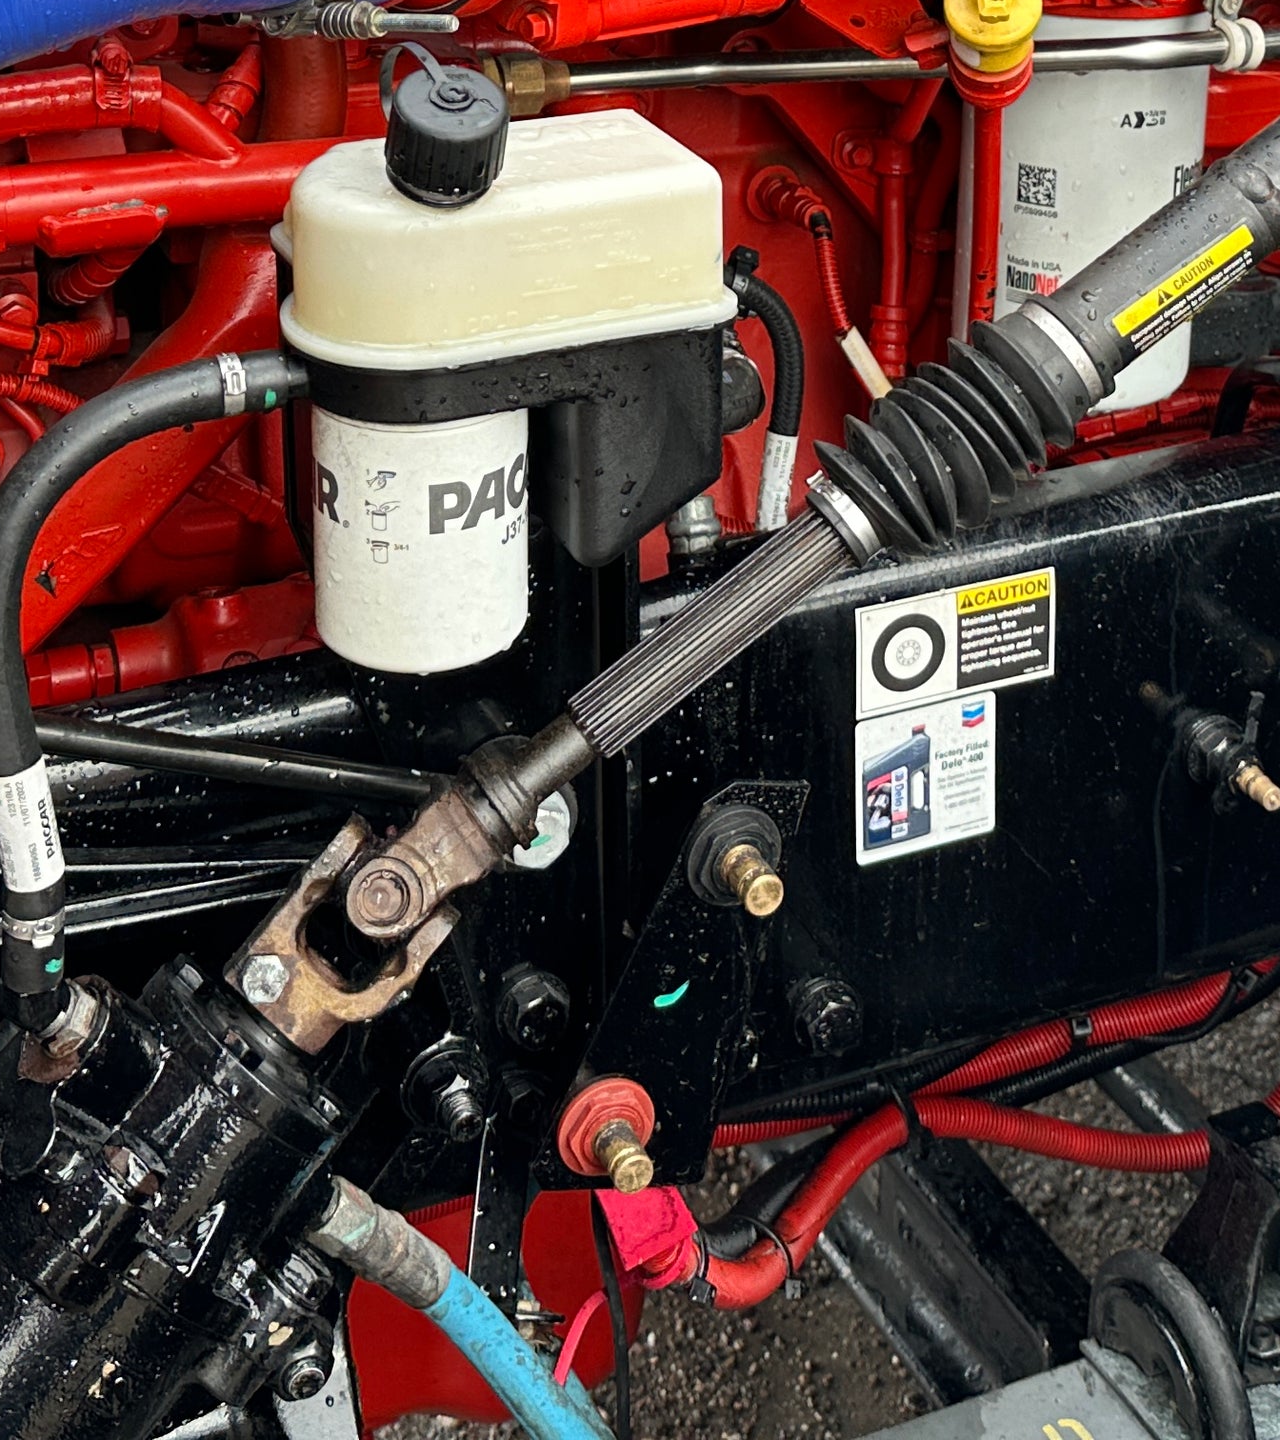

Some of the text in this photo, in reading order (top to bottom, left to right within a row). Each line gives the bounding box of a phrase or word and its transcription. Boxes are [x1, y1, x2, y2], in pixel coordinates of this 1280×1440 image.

[1006, 254, 1030, 268] Made
[1041, 260, 1062, 272] USA
[1173, 255, 1215, 291] CAUTION
[1006, 265, 1061, 297] NanoNet
[974, 578, 1048, 606] CAUTION
[961, 612, 996, 628] Maintain
[935, 747, 964, 761] Factory
[967, 751, 984, 764] 400
[894, 782, 905, 808] Delo
[37, 798, 55, 859] PACCAR
